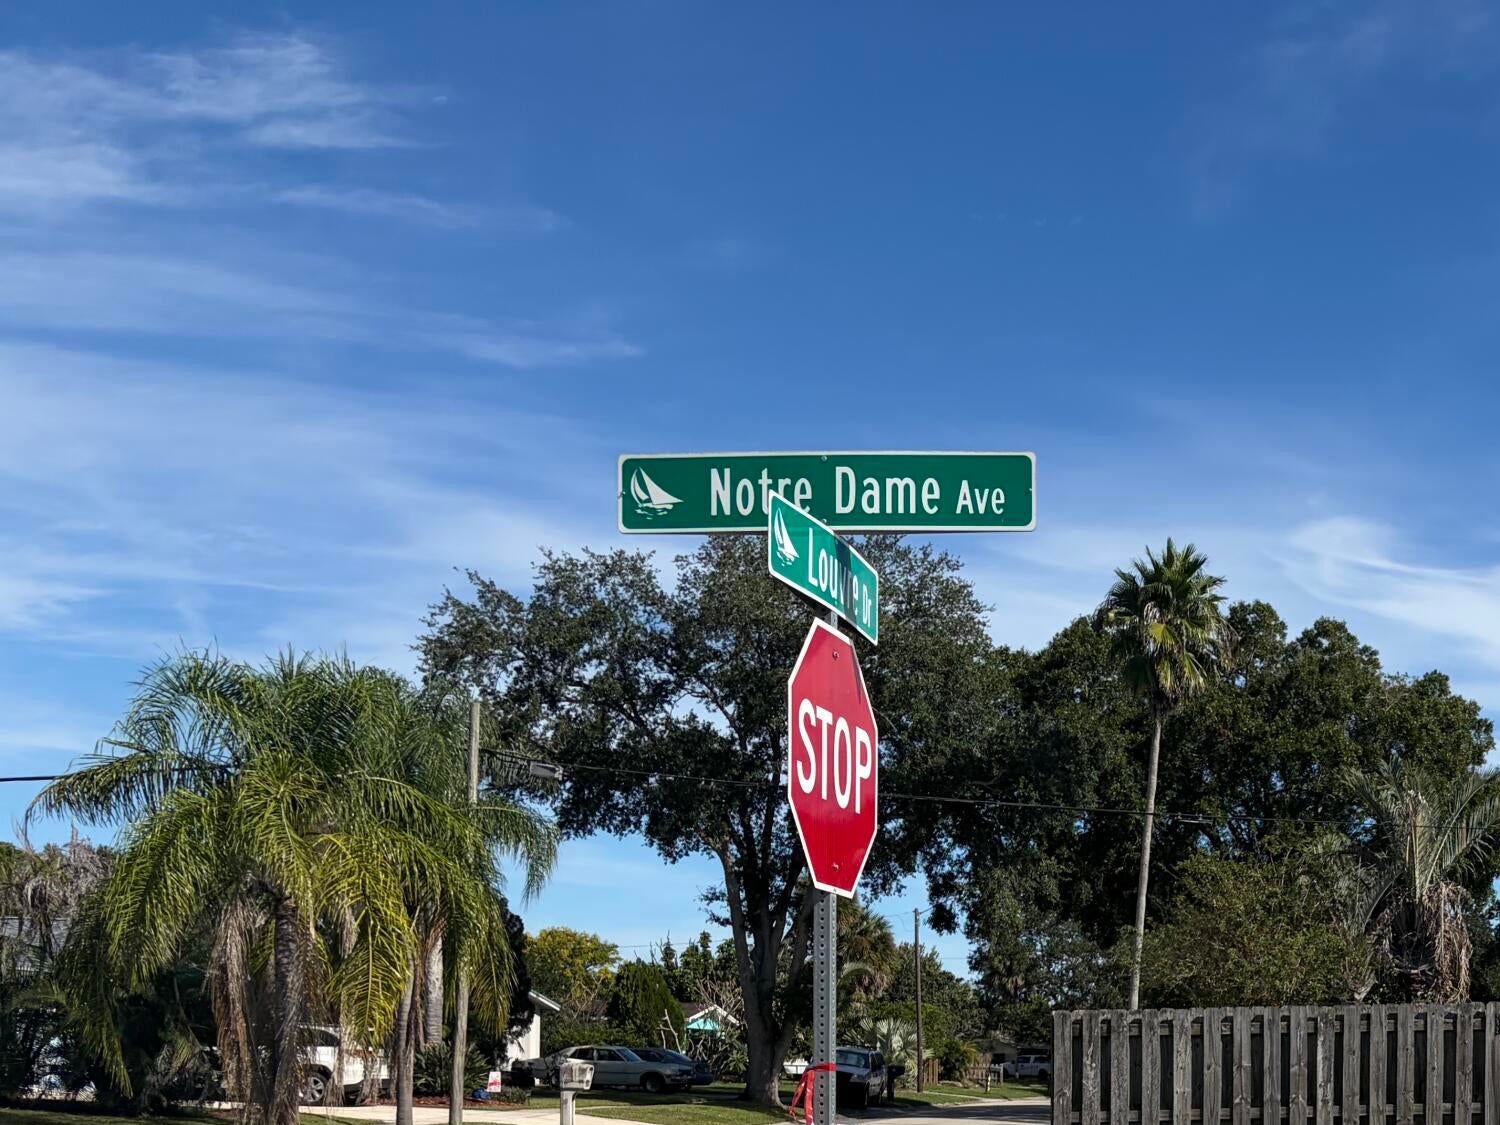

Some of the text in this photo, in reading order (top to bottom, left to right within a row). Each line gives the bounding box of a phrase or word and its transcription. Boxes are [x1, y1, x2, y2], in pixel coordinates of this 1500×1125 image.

[711, 466, 1006, 516] Notre Dame Ave
[808, 527, 872, 628] Louvre Dr
[796, 698, 872, 814] STOP
